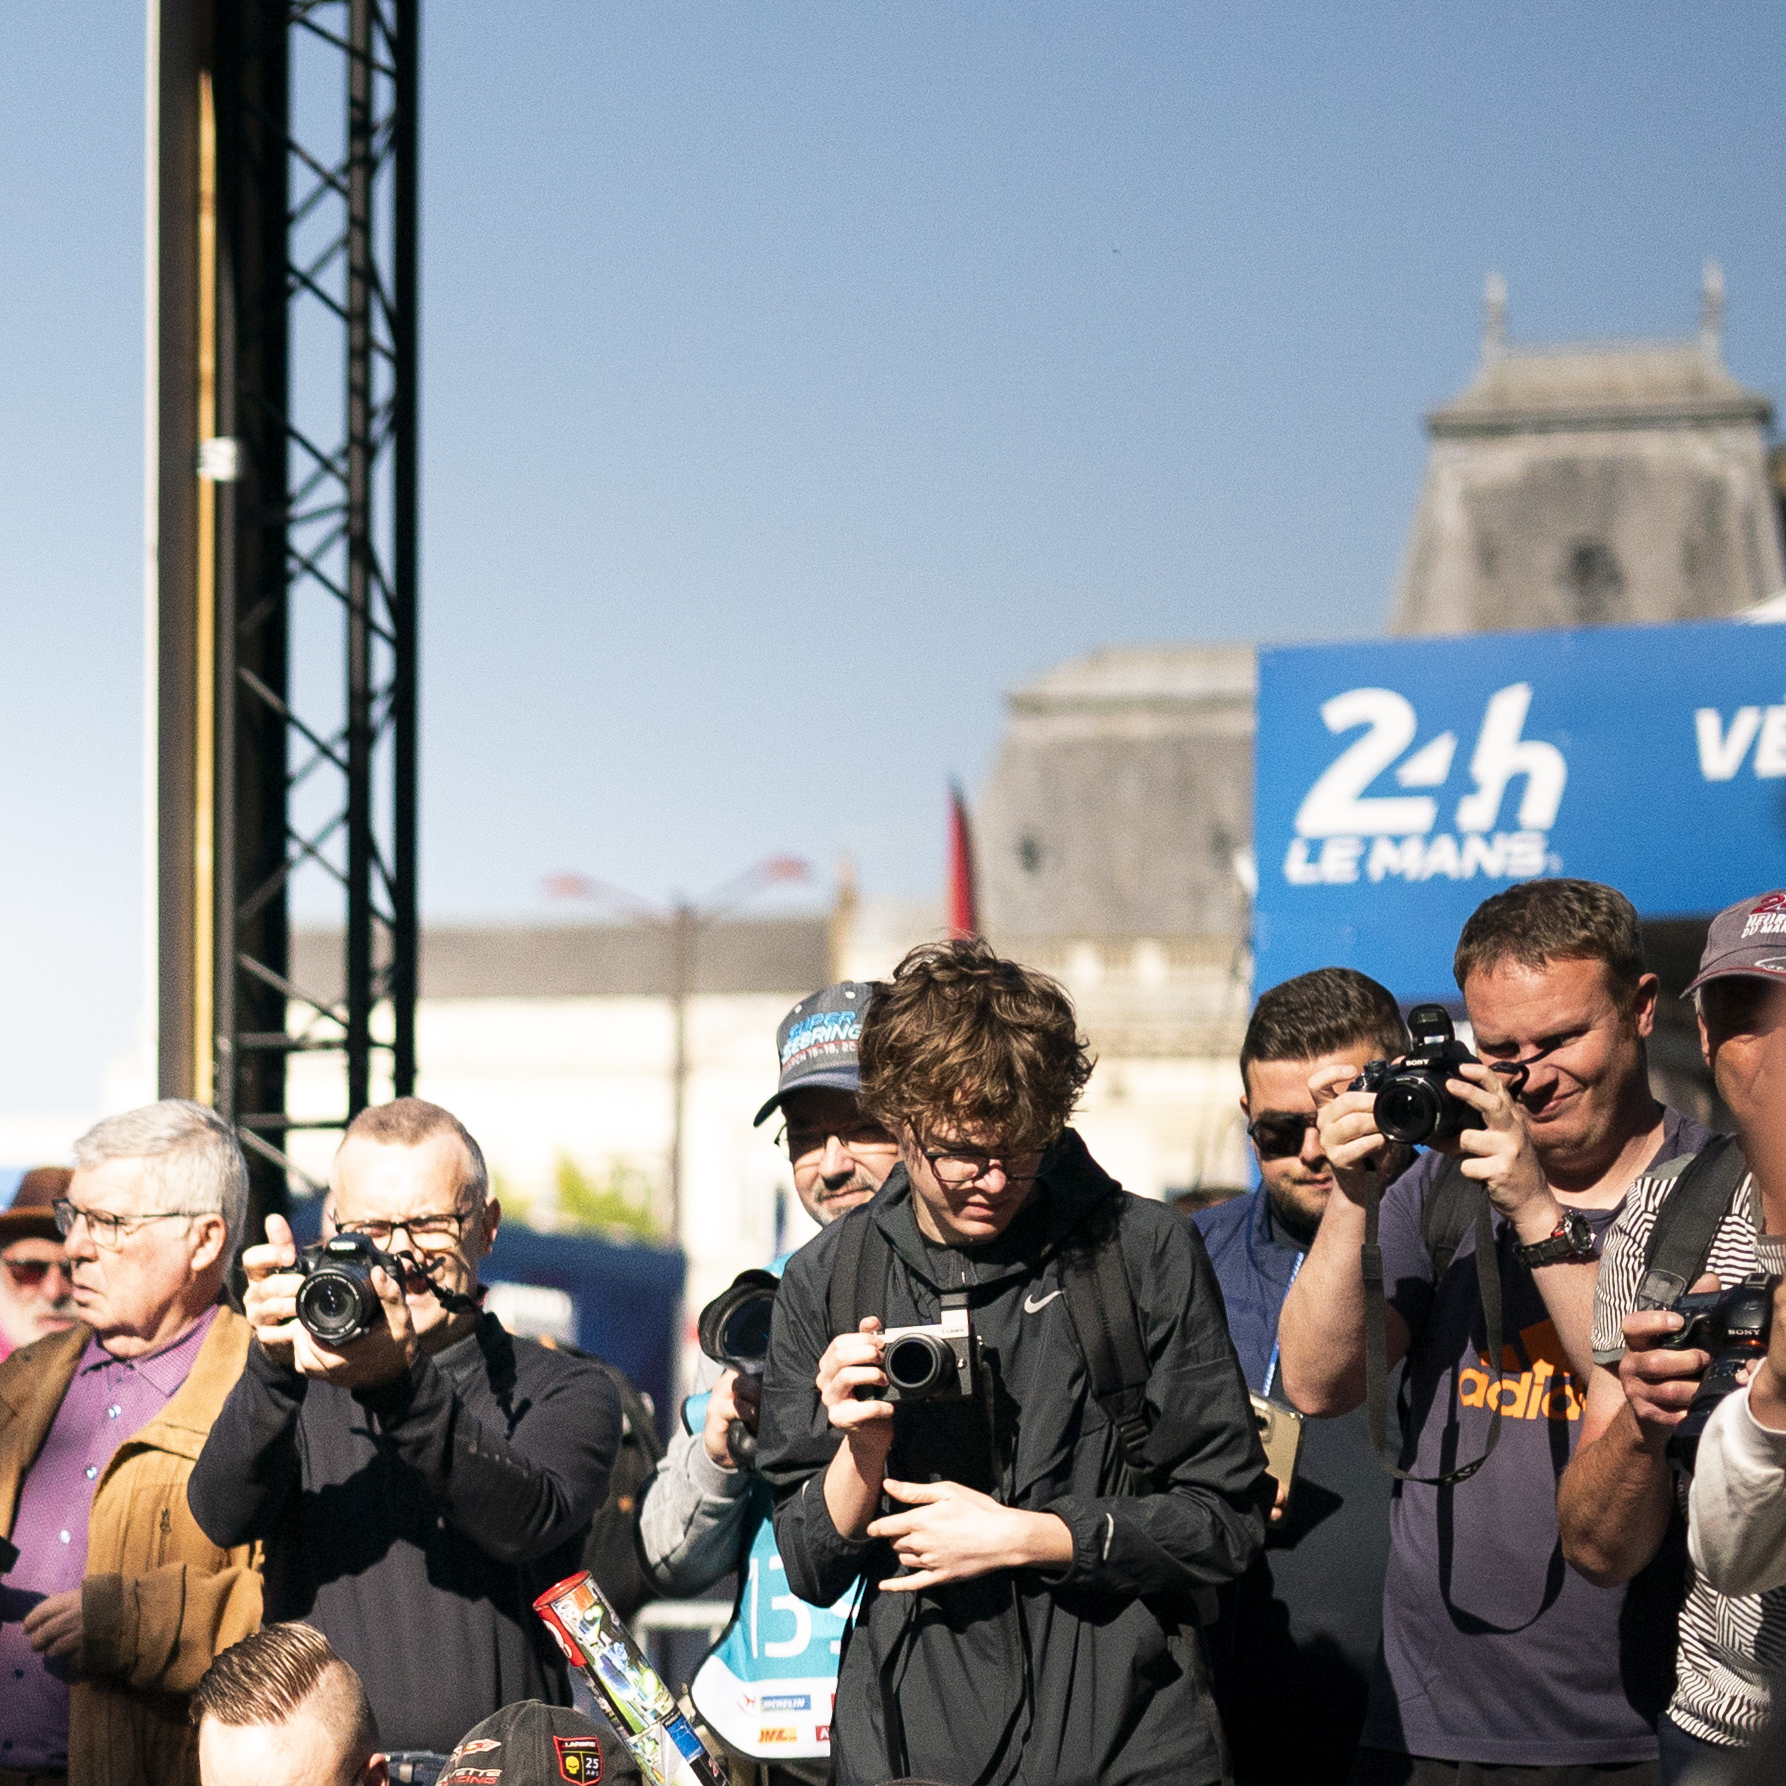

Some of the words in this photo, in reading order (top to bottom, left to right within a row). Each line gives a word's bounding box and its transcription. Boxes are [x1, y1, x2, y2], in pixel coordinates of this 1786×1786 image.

[1295, 681, 1569, 838] 24h
[1284, 836, 1365, 885] LE
[1366, 830, 1548, 884] MANS
[1405, 1058, 1430, 1067] SONY
[585, 1757, 599, 1769] 25
